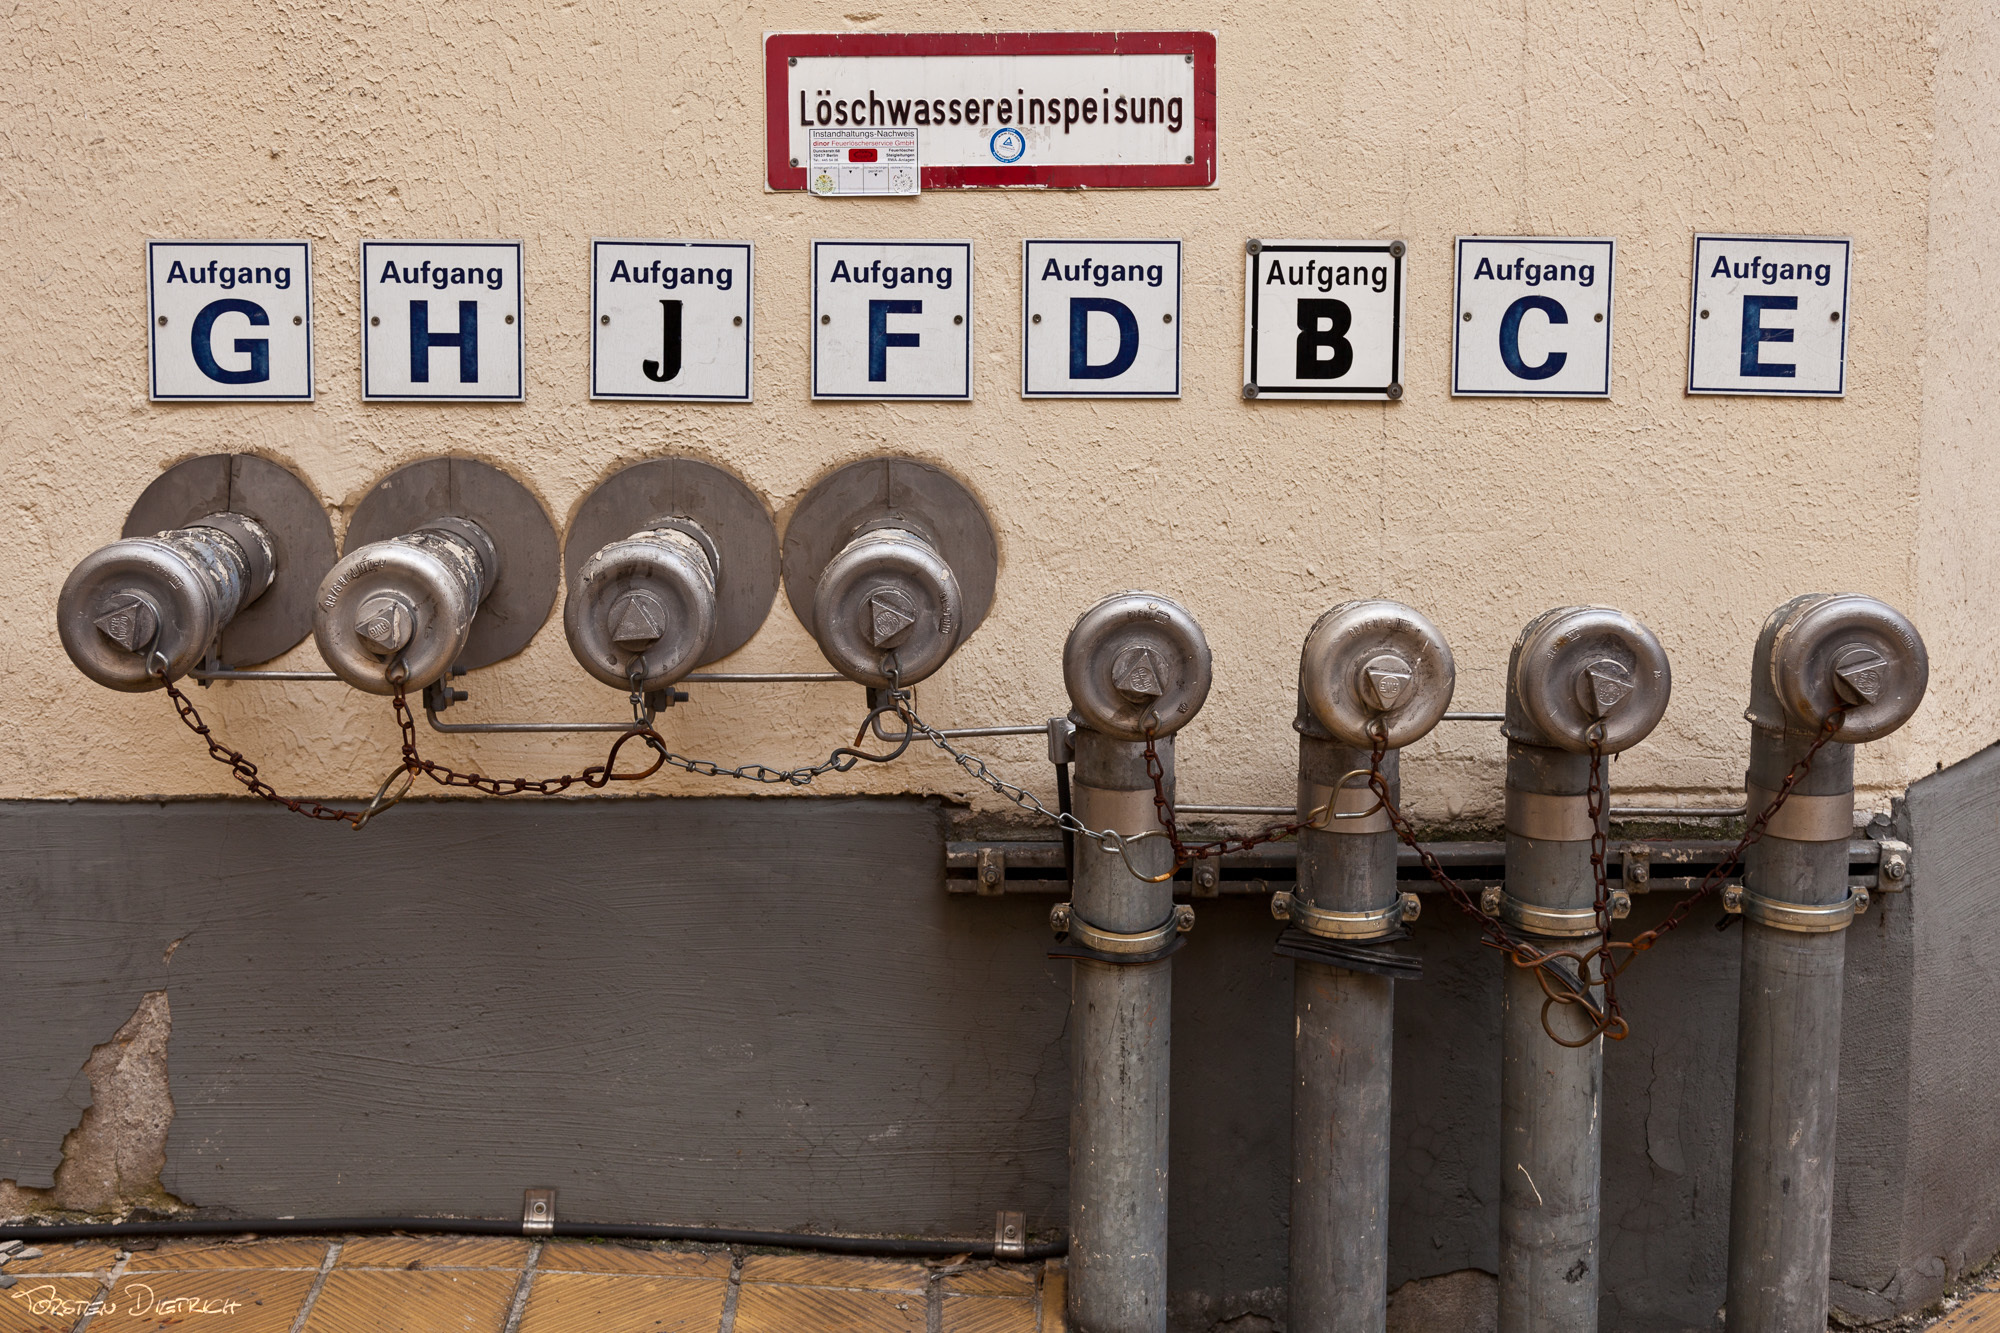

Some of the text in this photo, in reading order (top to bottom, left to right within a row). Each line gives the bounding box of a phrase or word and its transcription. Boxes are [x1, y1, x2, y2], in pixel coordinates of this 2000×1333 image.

[799, 88, 1184, 133] Löschwassereinspeisung
[812, 130, 915, 139] Instandhaltungs-Nachweis
[166, 260, 291, 289] Aufgang
[379, 260, 503, 290] Aufgang
[609, 259, 733, 291] Aufgang
[830, 259, 953, 290] Aufgang
[1041, 257, 1163, 287] Aufgang
[1265, 259, 1388, 293] Aufgang
[1473, 256, 1595, 287] Aufgang
[1710, 255, 1831, 286] Aufgang
[191, 298, 270, 385] G
[409, 300, 479, 383] H
[642, 299, 683, 382] J
[868, 299, 923, 382] F
[1069, 297, 1140, 380] D
[1295, 298, 1354, 380] B
[1498, 295, 1569, 381] C
[1739, 294, 1799, 378] E
